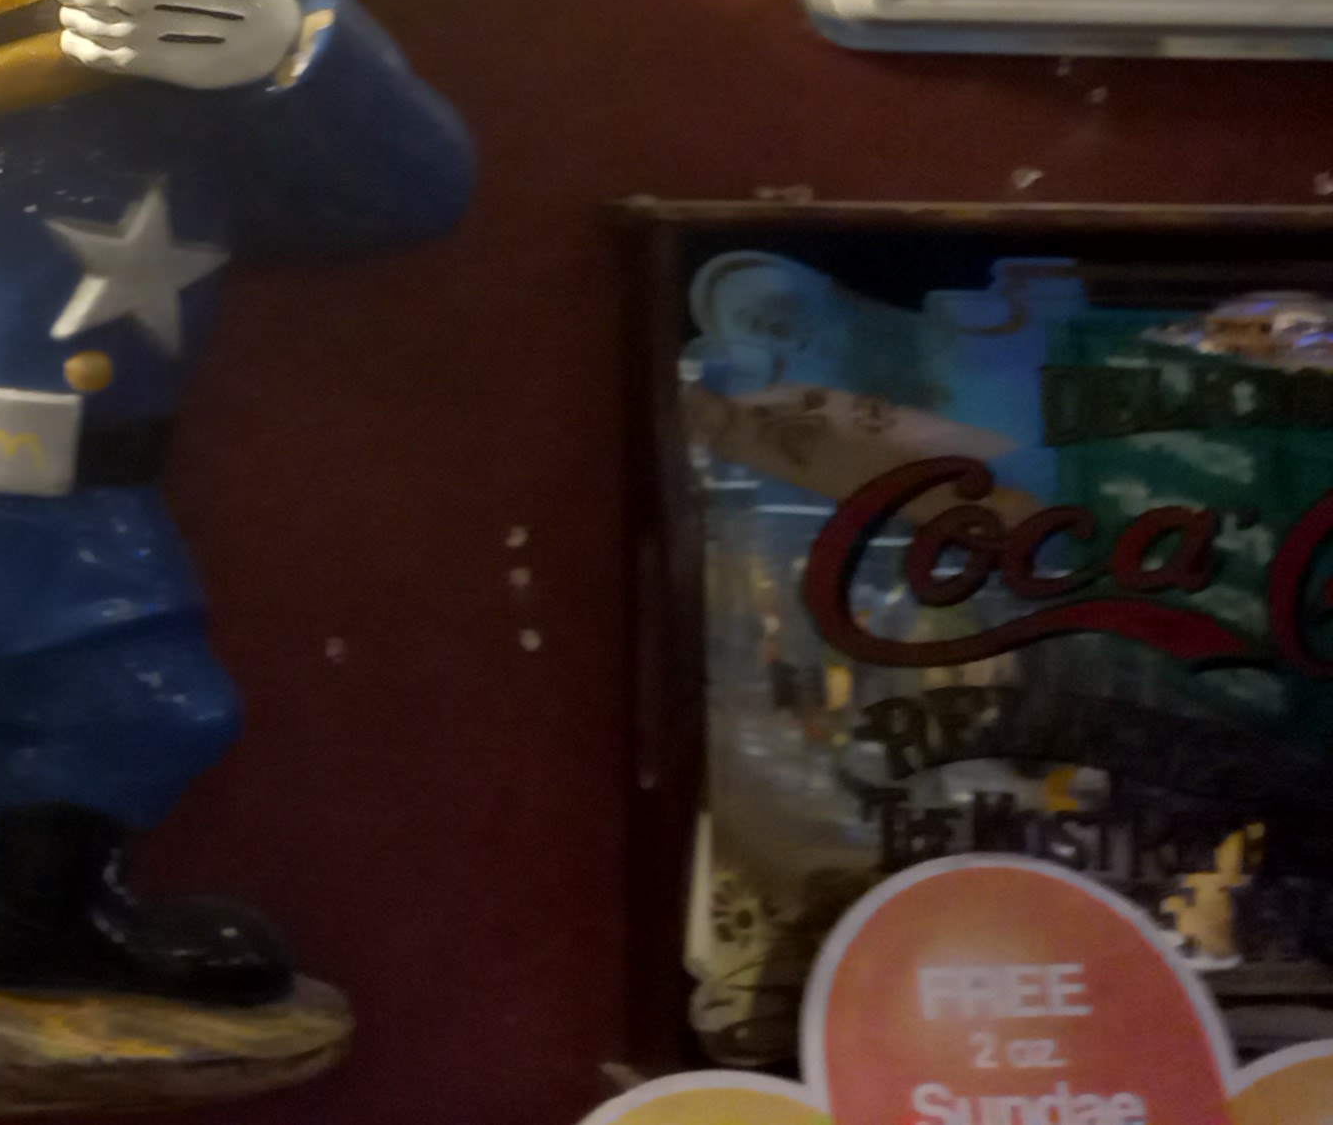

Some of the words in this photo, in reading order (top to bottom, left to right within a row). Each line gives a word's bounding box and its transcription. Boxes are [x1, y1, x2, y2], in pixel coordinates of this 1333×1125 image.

[917, 962, 1094, 1019] FREE
[970, 1031, 1000, 1069] 2
[912, 1080, 1148, 1125] Sundae
